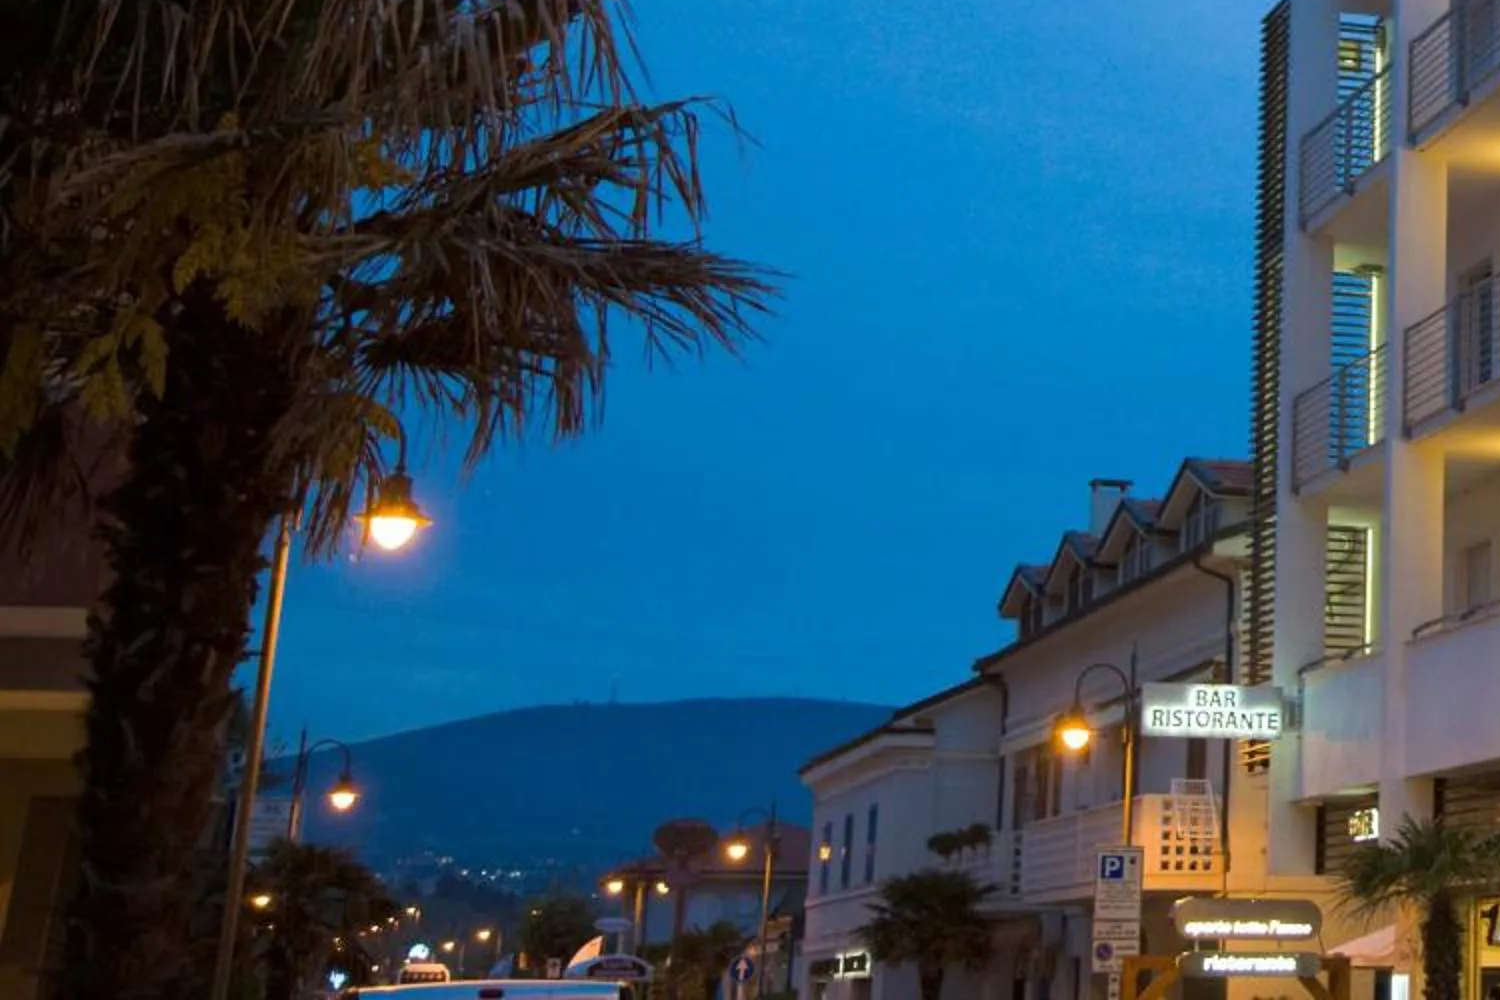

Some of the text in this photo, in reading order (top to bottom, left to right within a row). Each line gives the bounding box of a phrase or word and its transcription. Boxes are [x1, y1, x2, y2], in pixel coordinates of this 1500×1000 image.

[1195, 689, 1237, 708] BAR
[1151, 708, 1280, 731] RISTORANTE
[1104, 856, 1121, 877] P
